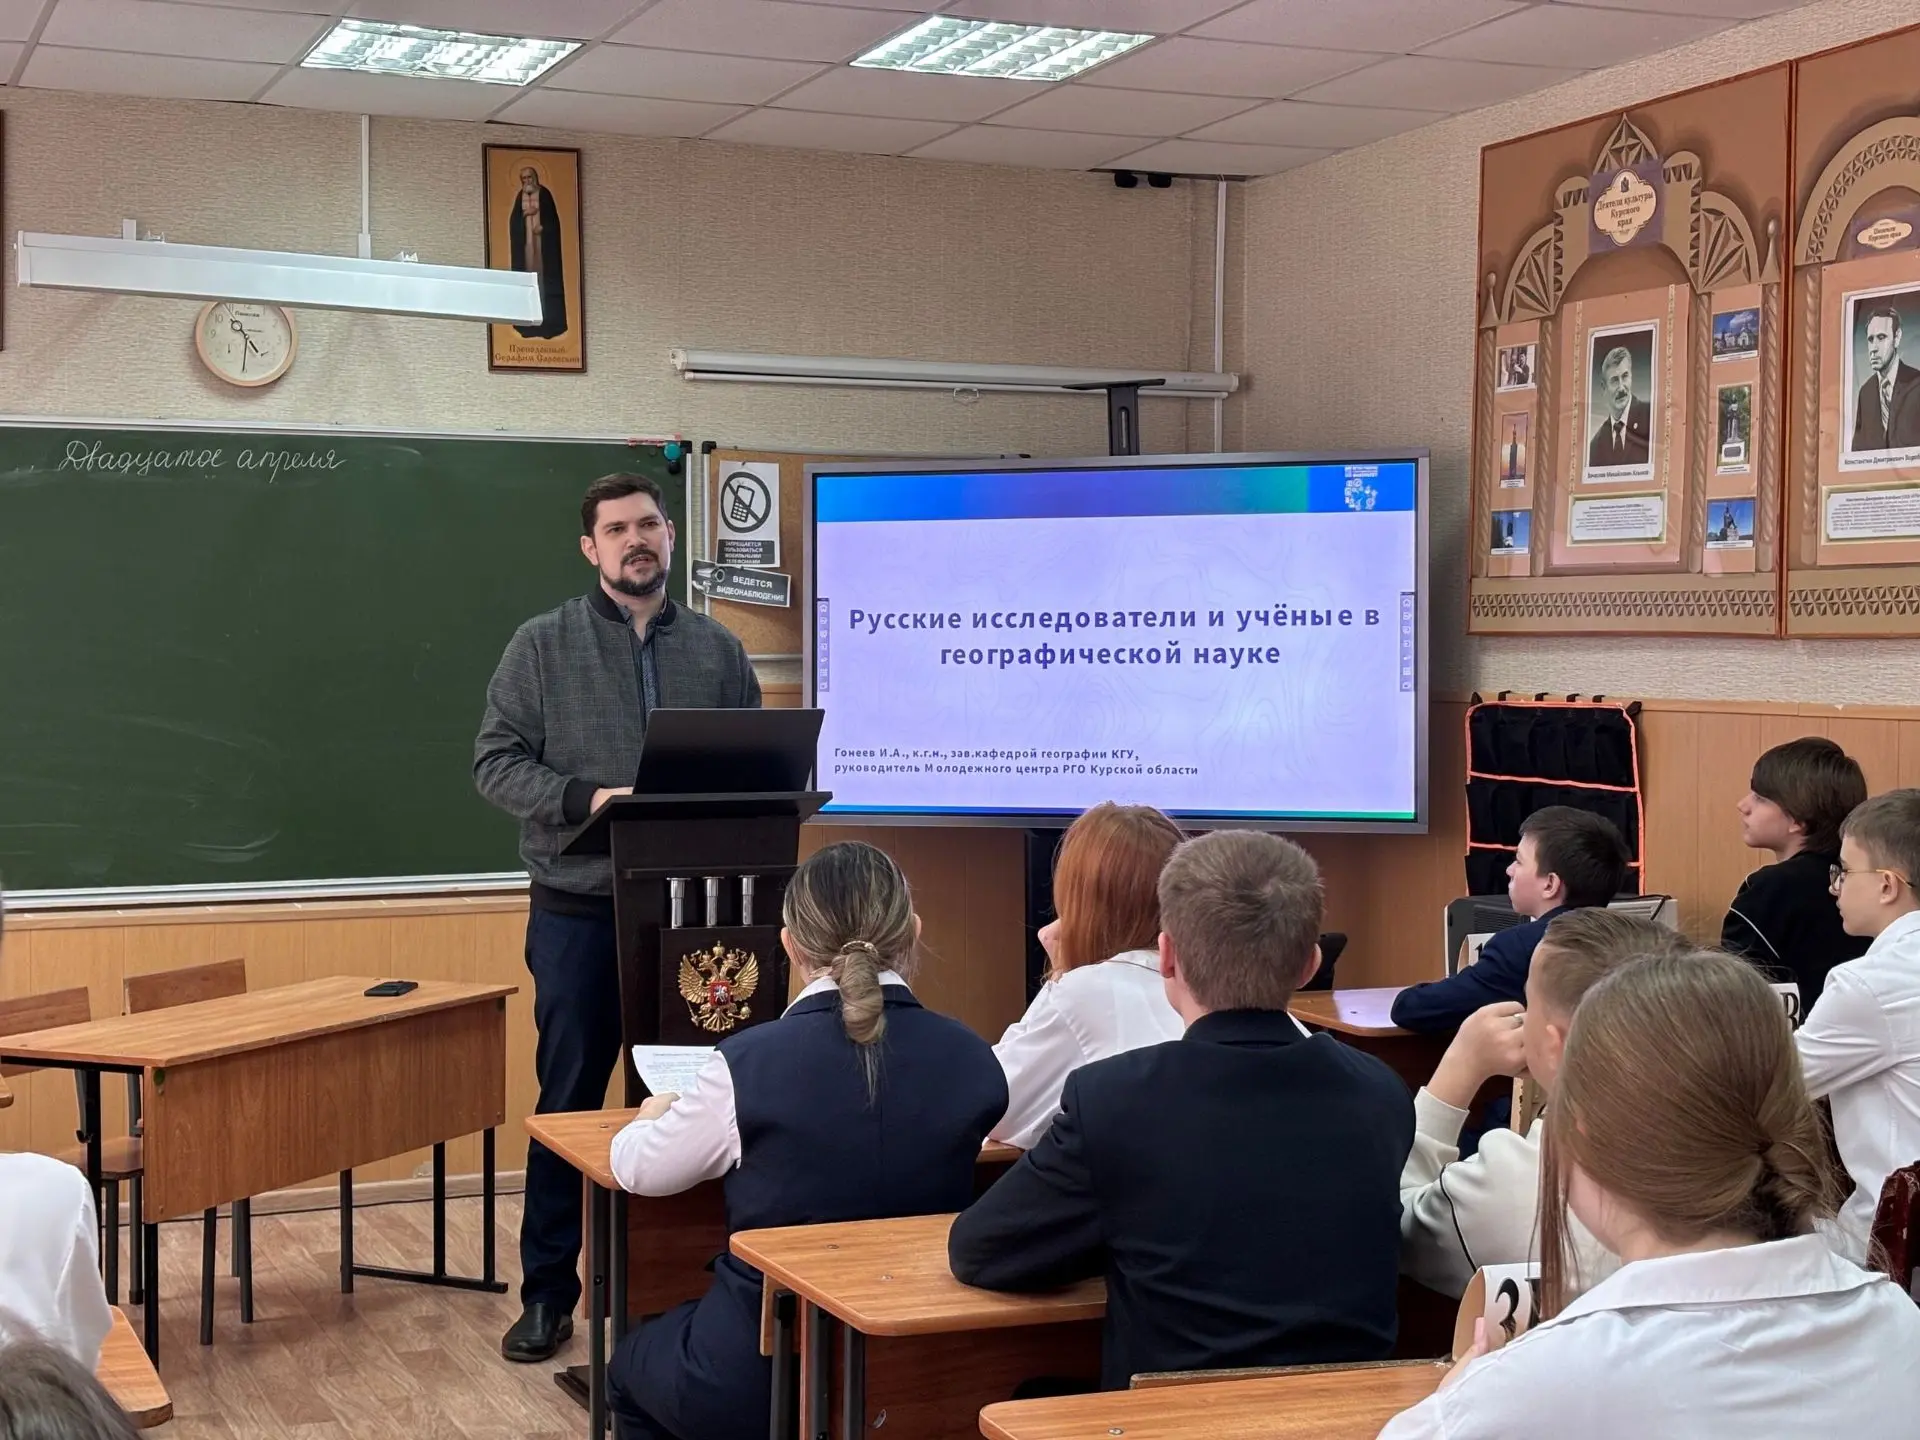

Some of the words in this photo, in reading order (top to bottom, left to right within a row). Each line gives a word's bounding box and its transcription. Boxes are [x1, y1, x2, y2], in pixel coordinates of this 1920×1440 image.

[1597, 199, 1623, 211] Деятели
[1624, 192, 1654, 206] культуры
[1611, 206, 1640, 219] Курского
[1617, 218, 1633, 228] края
[58, 440, 228, 476] Двадцатое
[236, 449, 348, 483] апреля
[732, 575, 773, 588] ВЕДЕТСЯ
[716, 585, 785, 602] ВИДЕОНАБЛЮДЕНИЕ
[850, 609, 962, 634] Русские
[972, 610, 1196, 633] исследователи
[1208, 610, 1224, 627] и
[1236, 603, 1353, 632] учёные
[1365, 609, 1380, 626] в
[941, 640, 1180, 669] географической
[1194, 647, 1280, 669] науке
[834, 748, 875, 757] Гонеев
[879, 748, 909, 760] И.А.,
[912, 749, 948, 760] к.г.н.,
[951, 748, 1037, 760] зав.кафедрой
[1041, 749, 1107, 760] географии
[1111, 749, 1139, 760] КГУ,
[834, 764, 920, 774] руководитель
[924, 764, 1012, 774] Молодежного
[1016, 765, 1059, 775] центра
[1063, 764, 1086, 774] РГО
[1090, 764, 1143, 776] Курской
[1147, 764, 1198, 774] области
